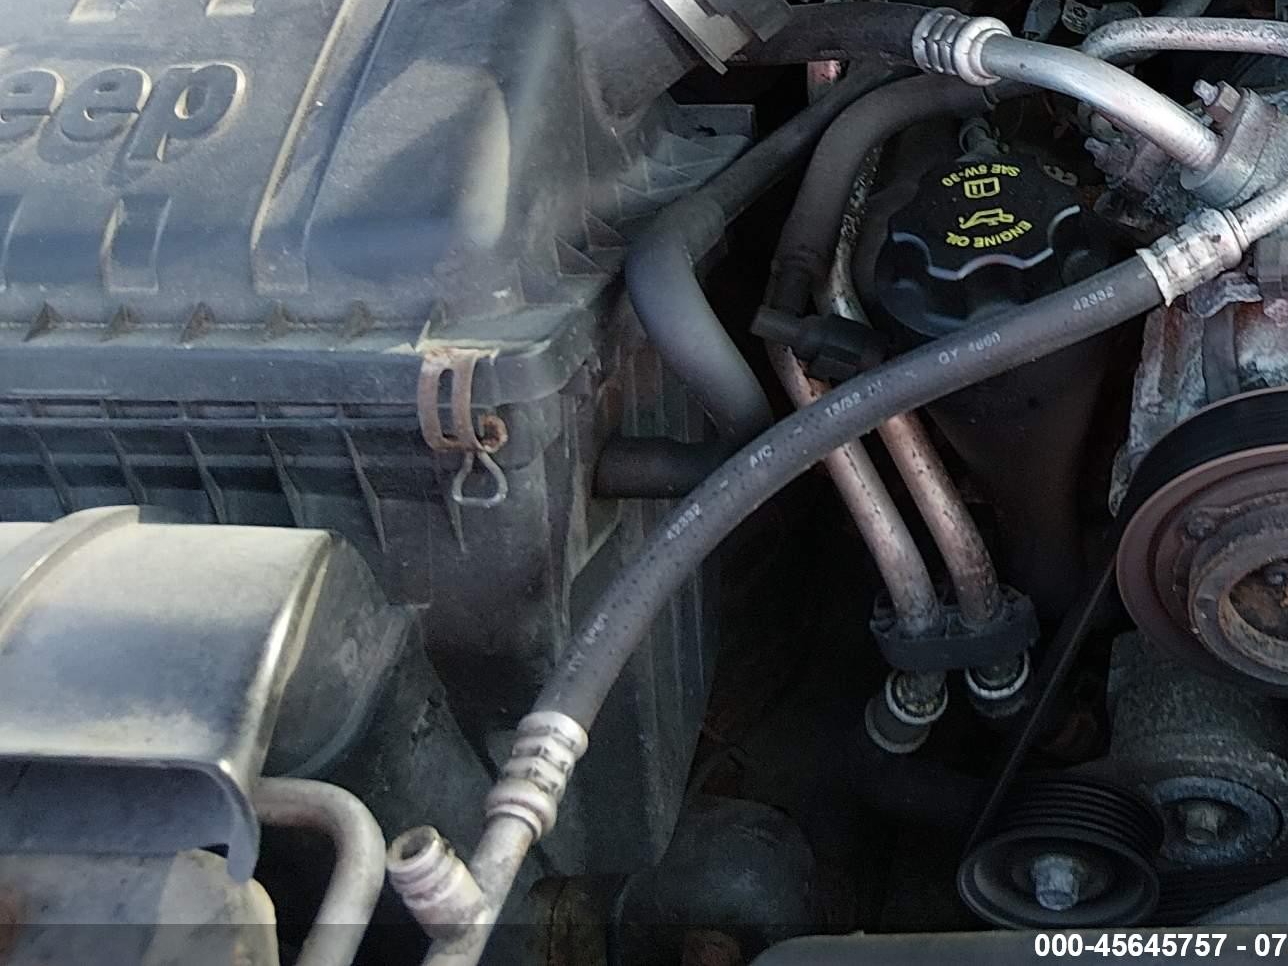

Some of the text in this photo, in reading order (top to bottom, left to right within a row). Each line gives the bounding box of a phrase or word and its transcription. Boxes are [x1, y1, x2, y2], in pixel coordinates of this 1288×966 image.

[941, 164, 988, 187] 5W-30
[991, 163, 1021, 177] SAE
[946, 220, 1033, 248] ENGINE OIL
